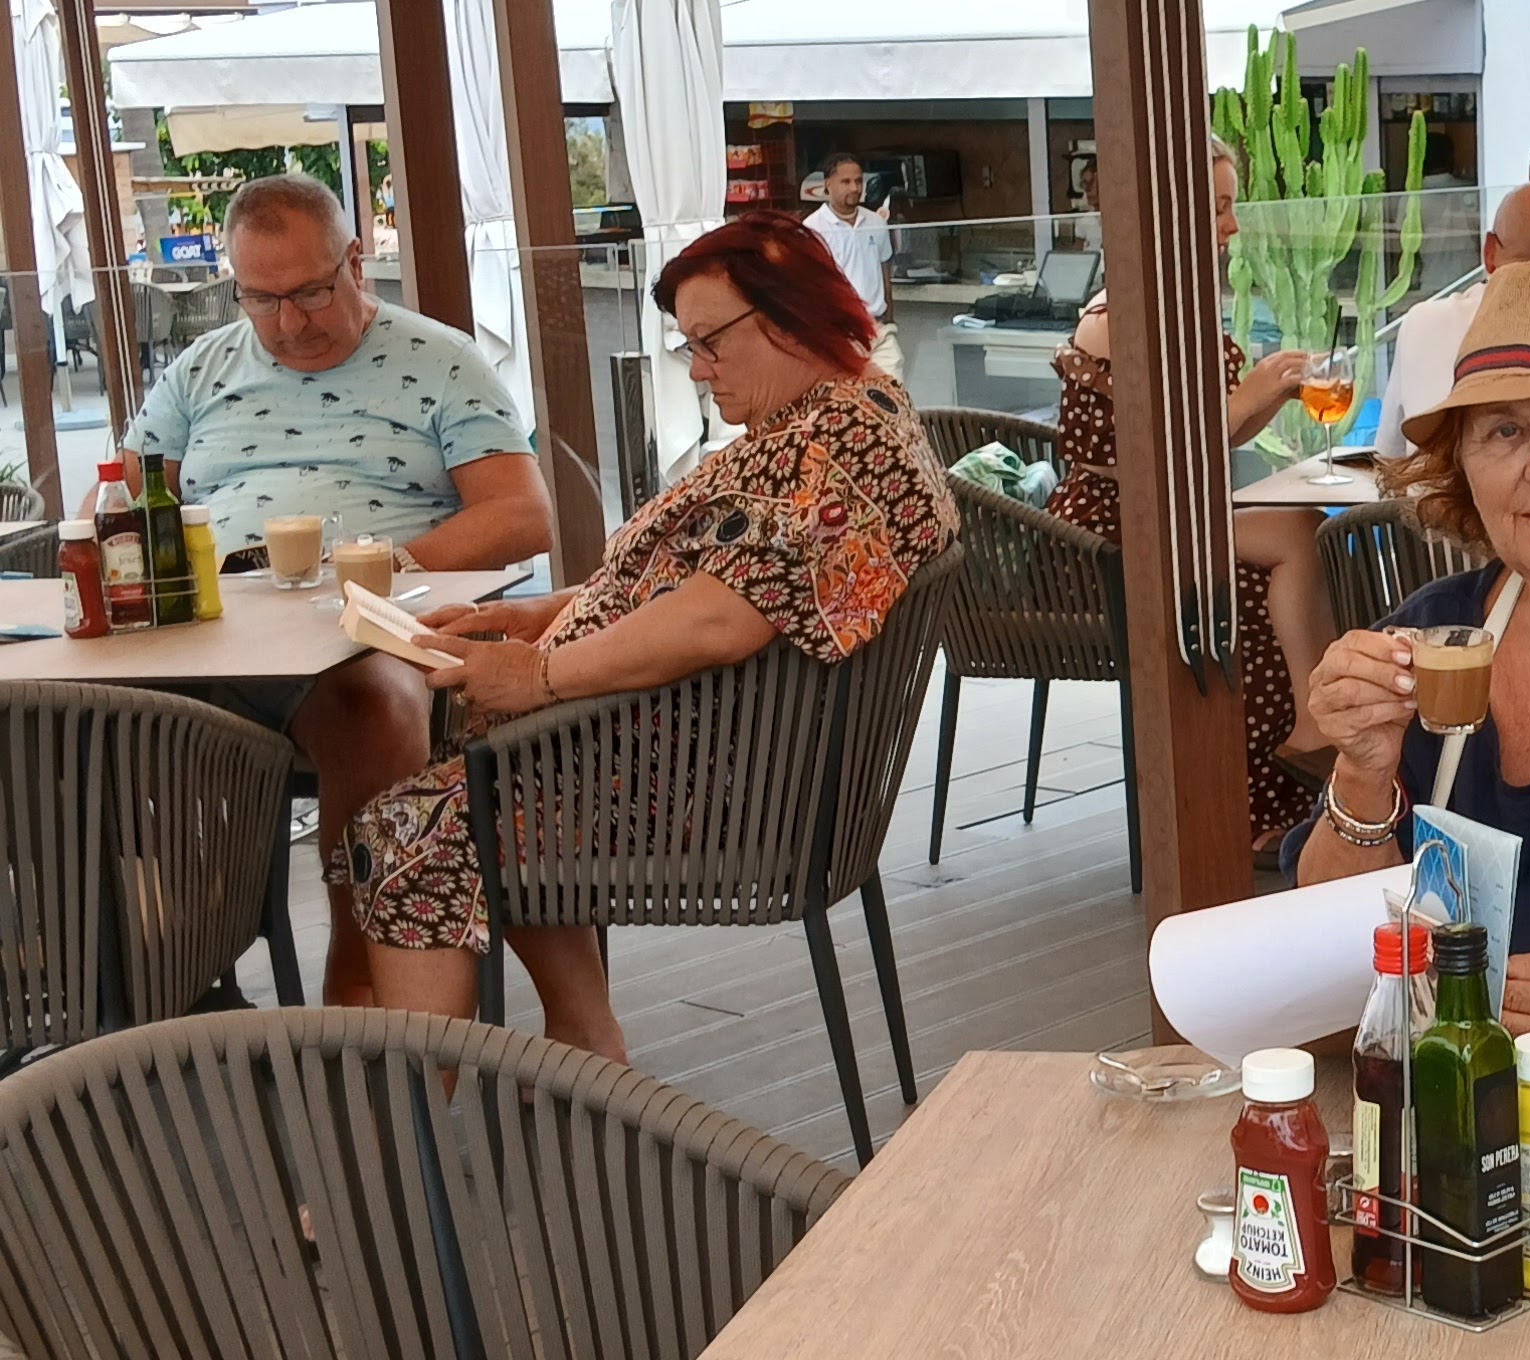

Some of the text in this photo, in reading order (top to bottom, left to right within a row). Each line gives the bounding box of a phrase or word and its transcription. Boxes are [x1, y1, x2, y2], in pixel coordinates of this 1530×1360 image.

[1241, 1221, 1285, 1242] KETCHUP
[1240, 1234, 1289, 1258] TOMATO
[1246, 1260, 1282, 1281] HEINZ
